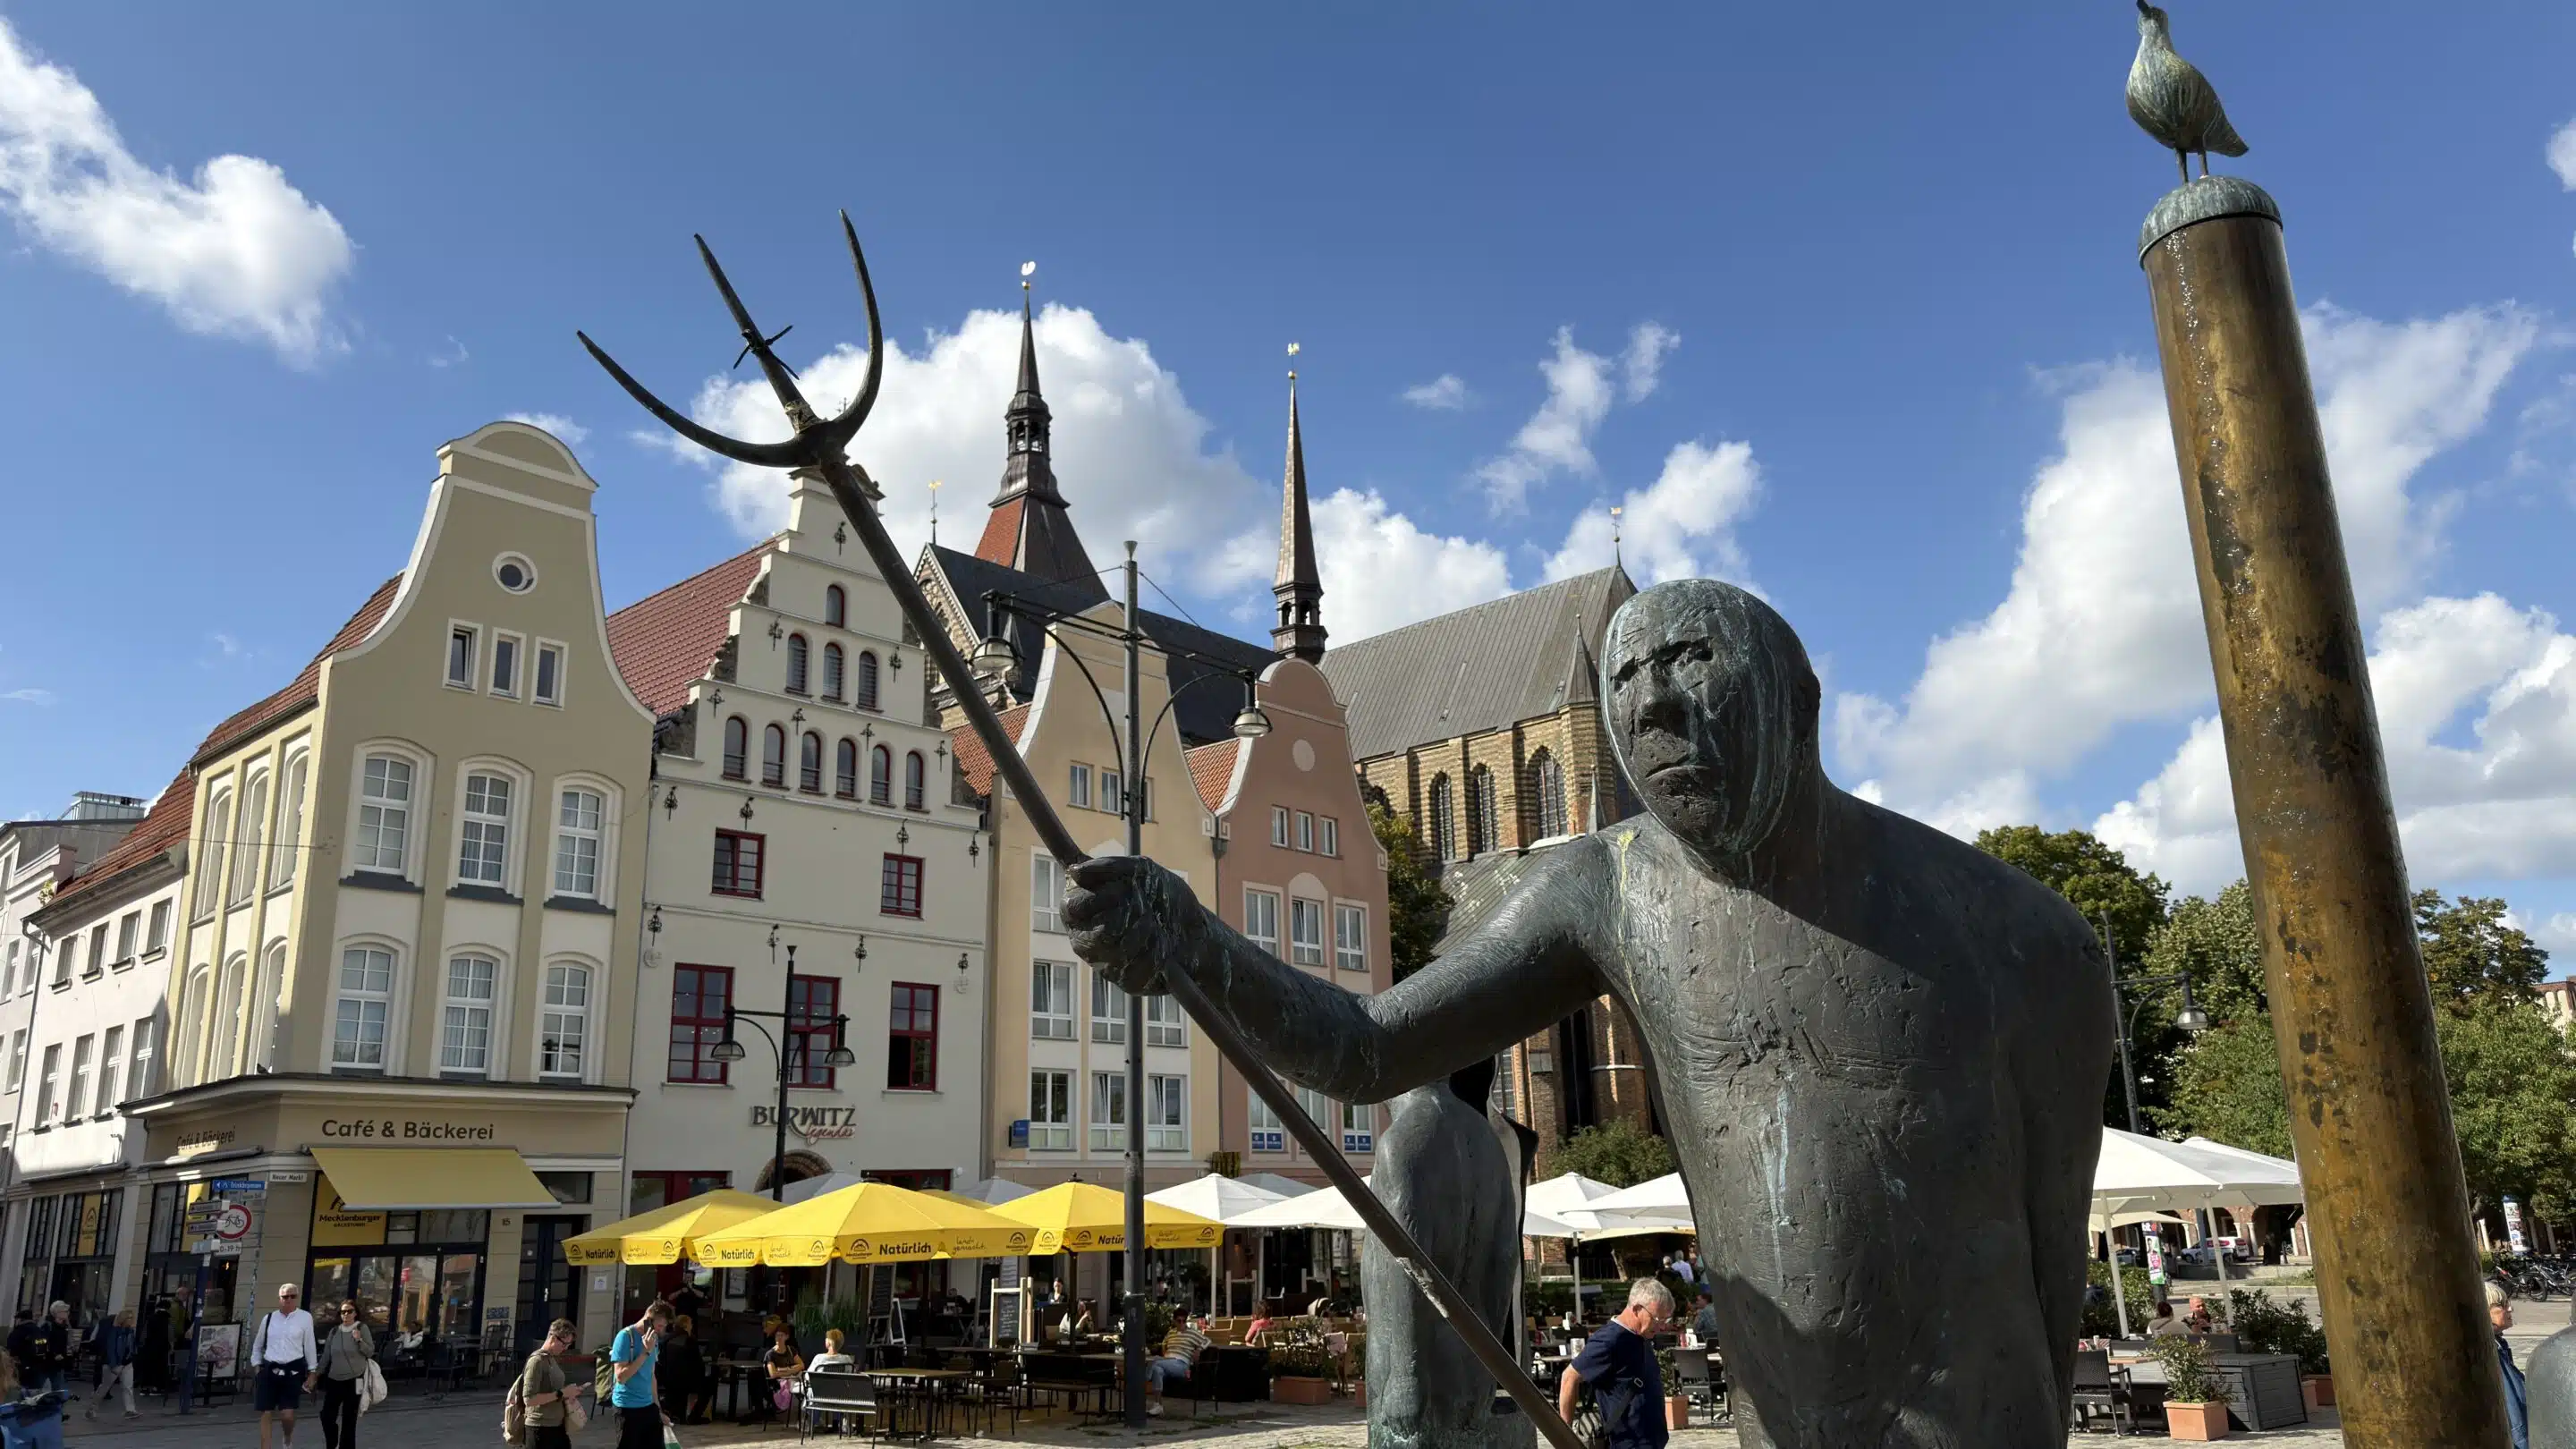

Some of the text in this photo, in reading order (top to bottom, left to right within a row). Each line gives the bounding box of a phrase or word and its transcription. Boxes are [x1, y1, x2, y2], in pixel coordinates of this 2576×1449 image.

[752, 1106, 857, 1131] BURWITZ
[322, 1119, 494, 1140] Café & Bäckerei
[177, 1131, 194, 1150] Café
[201, 1123, 236, 1147] Bäckerei
[272, 1173, 304, 1181] Neuer Markt
[318, 1214, 381, 1223] Mecklenburger
[502, 1217, 511, 1226] 15
[1098, 1233, 1124, 1244] Natür
[585, 1248, 615, 1259] Natürlich
[721, 1248, 755, 1259] Natürlich
[879, 1242, 931, 1255] Natürlich
